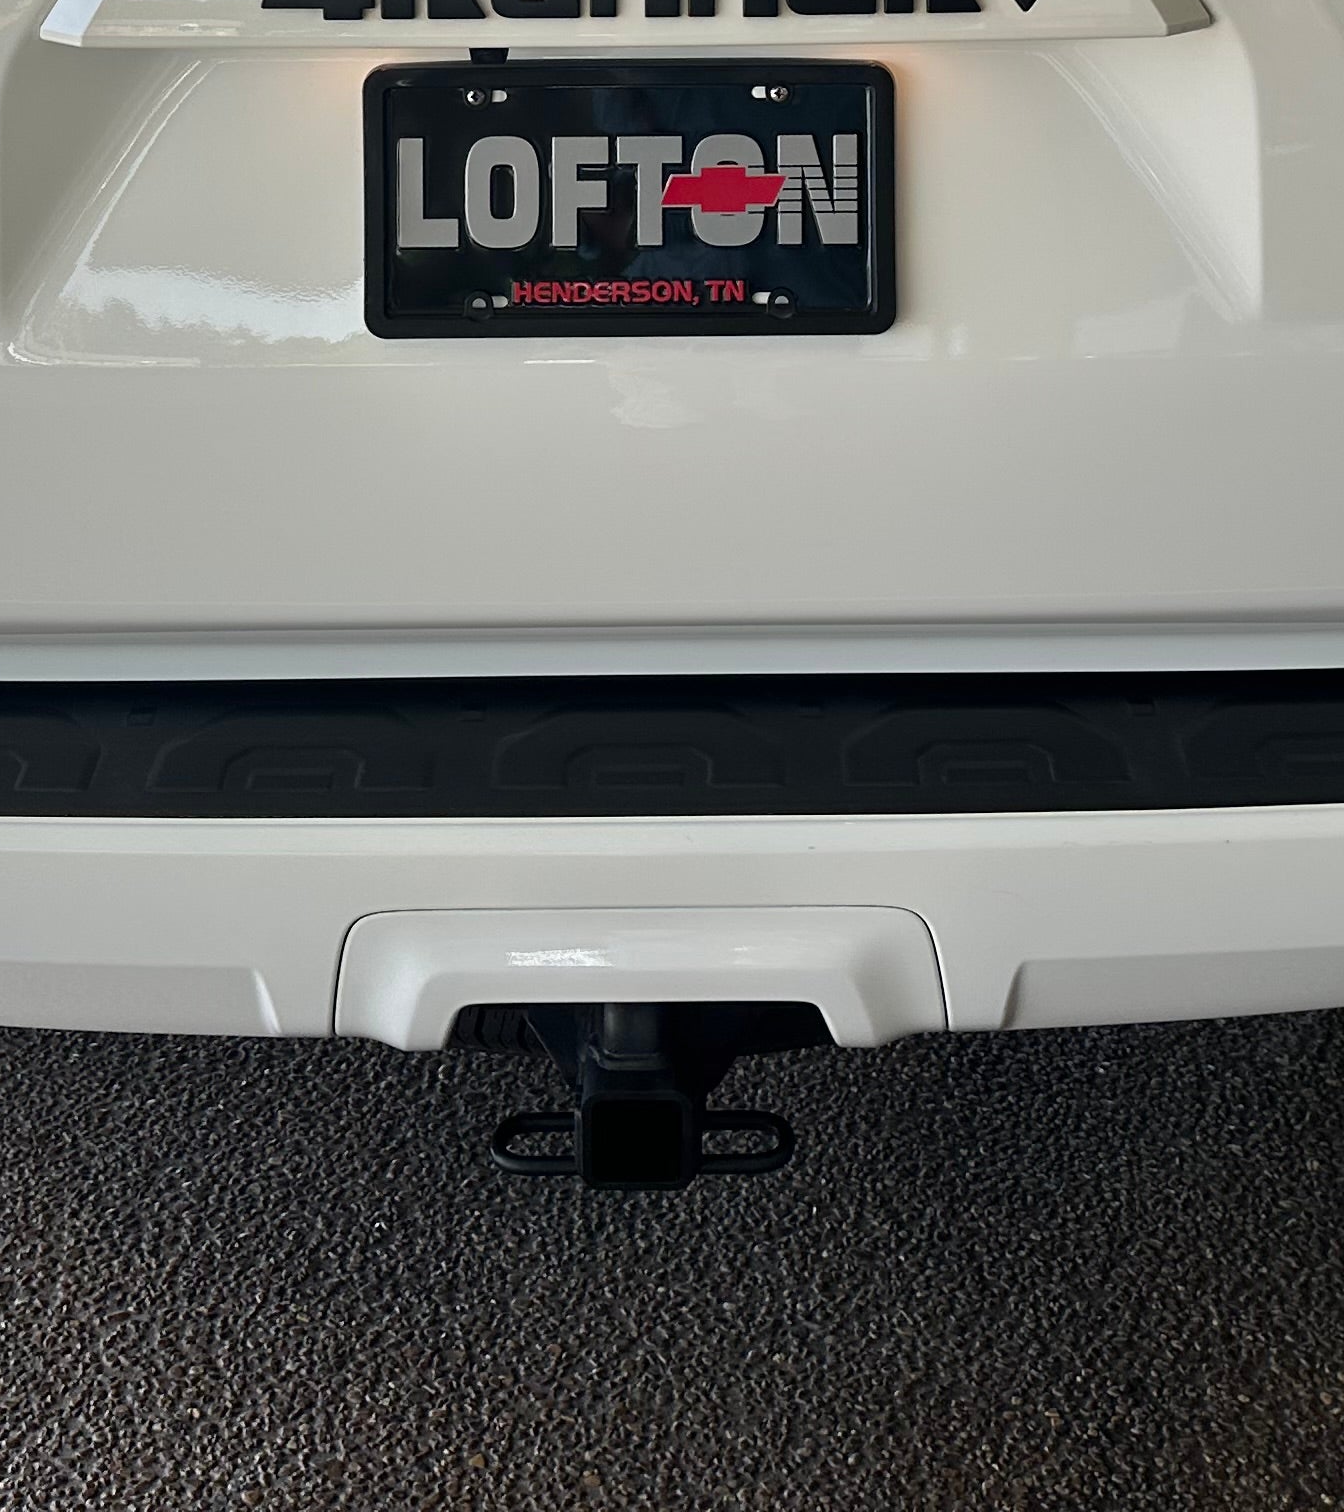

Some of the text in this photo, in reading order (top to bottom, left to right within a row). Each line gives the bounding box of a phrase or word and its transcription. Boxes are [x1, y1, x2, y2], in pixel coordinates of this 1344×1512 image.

[396, 133, 858, 249] LOFTON
[512, 280, 744, 306] HENDERSON, TN
